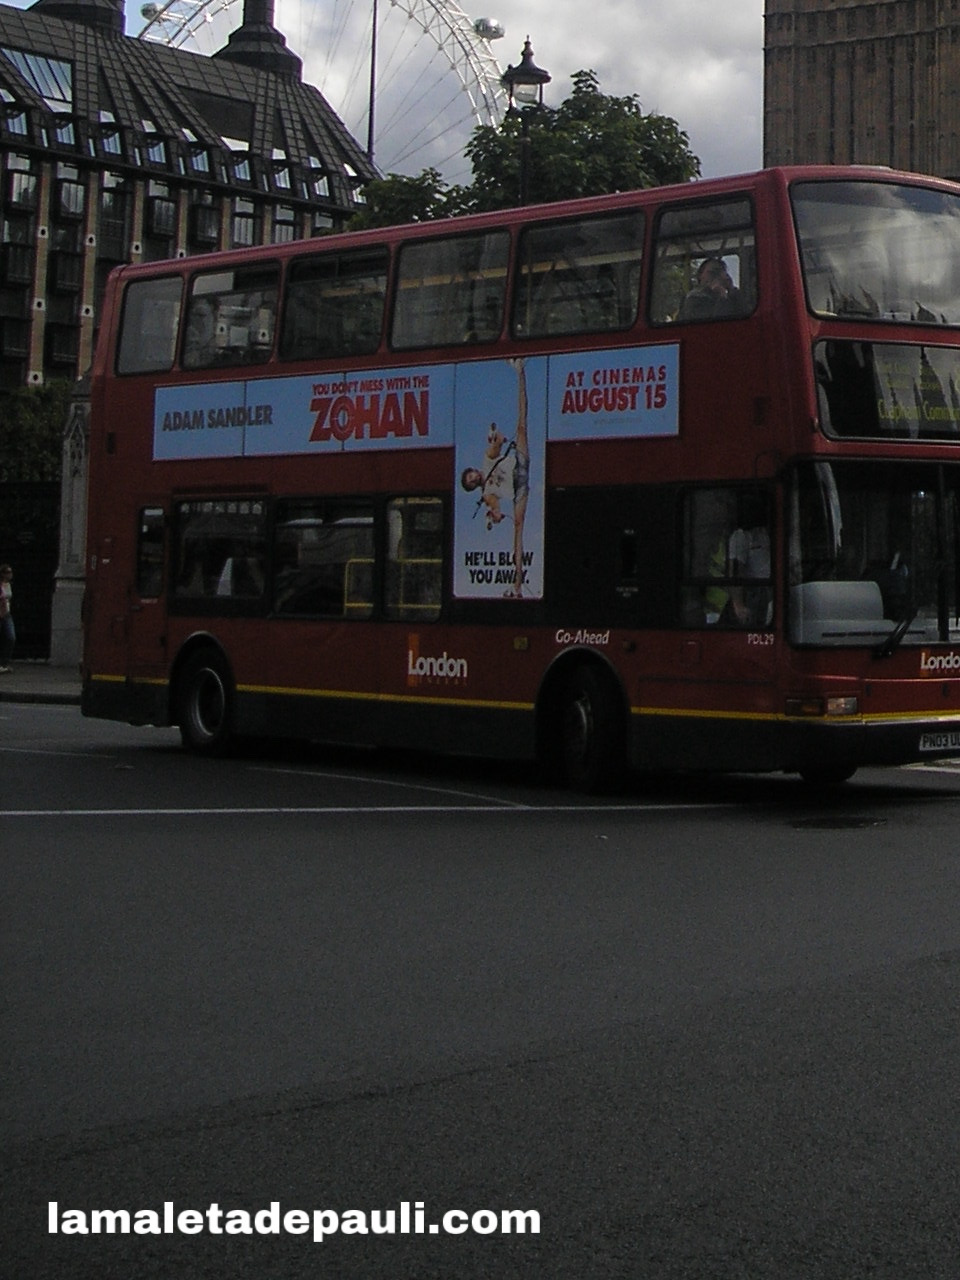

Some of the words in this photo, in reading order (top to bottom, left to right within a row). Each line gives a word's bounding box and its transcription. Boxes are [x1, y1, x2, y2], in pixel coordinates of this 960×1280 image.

[312, 383, 330, 395] YOU
[331, 381, 358, 394] DON'T
[360, 379, 384, 392] MESS
[386, 377, 411, 390] WITH
[413, 375, 430, 388] THE
[566, 371, 585, 387] AT
[593, 365, 666, 385] CINEMAS
[562, 386, 639, 414] AUGUST
[645, 384, 667, 409] 15
[162, 412, 204, 431] ADAM
[207, 405, 273, 430] SANDLER
[309, 391, 429, 442] ZOHAN
[465, 552, 496, 566] HE'LL
[470, 569, 493, 584] YOU
[555, 629, 611, 645] Go-Ahead
[747, 633, 775, 646] PDL29
[408, 649, 468, 678] London
